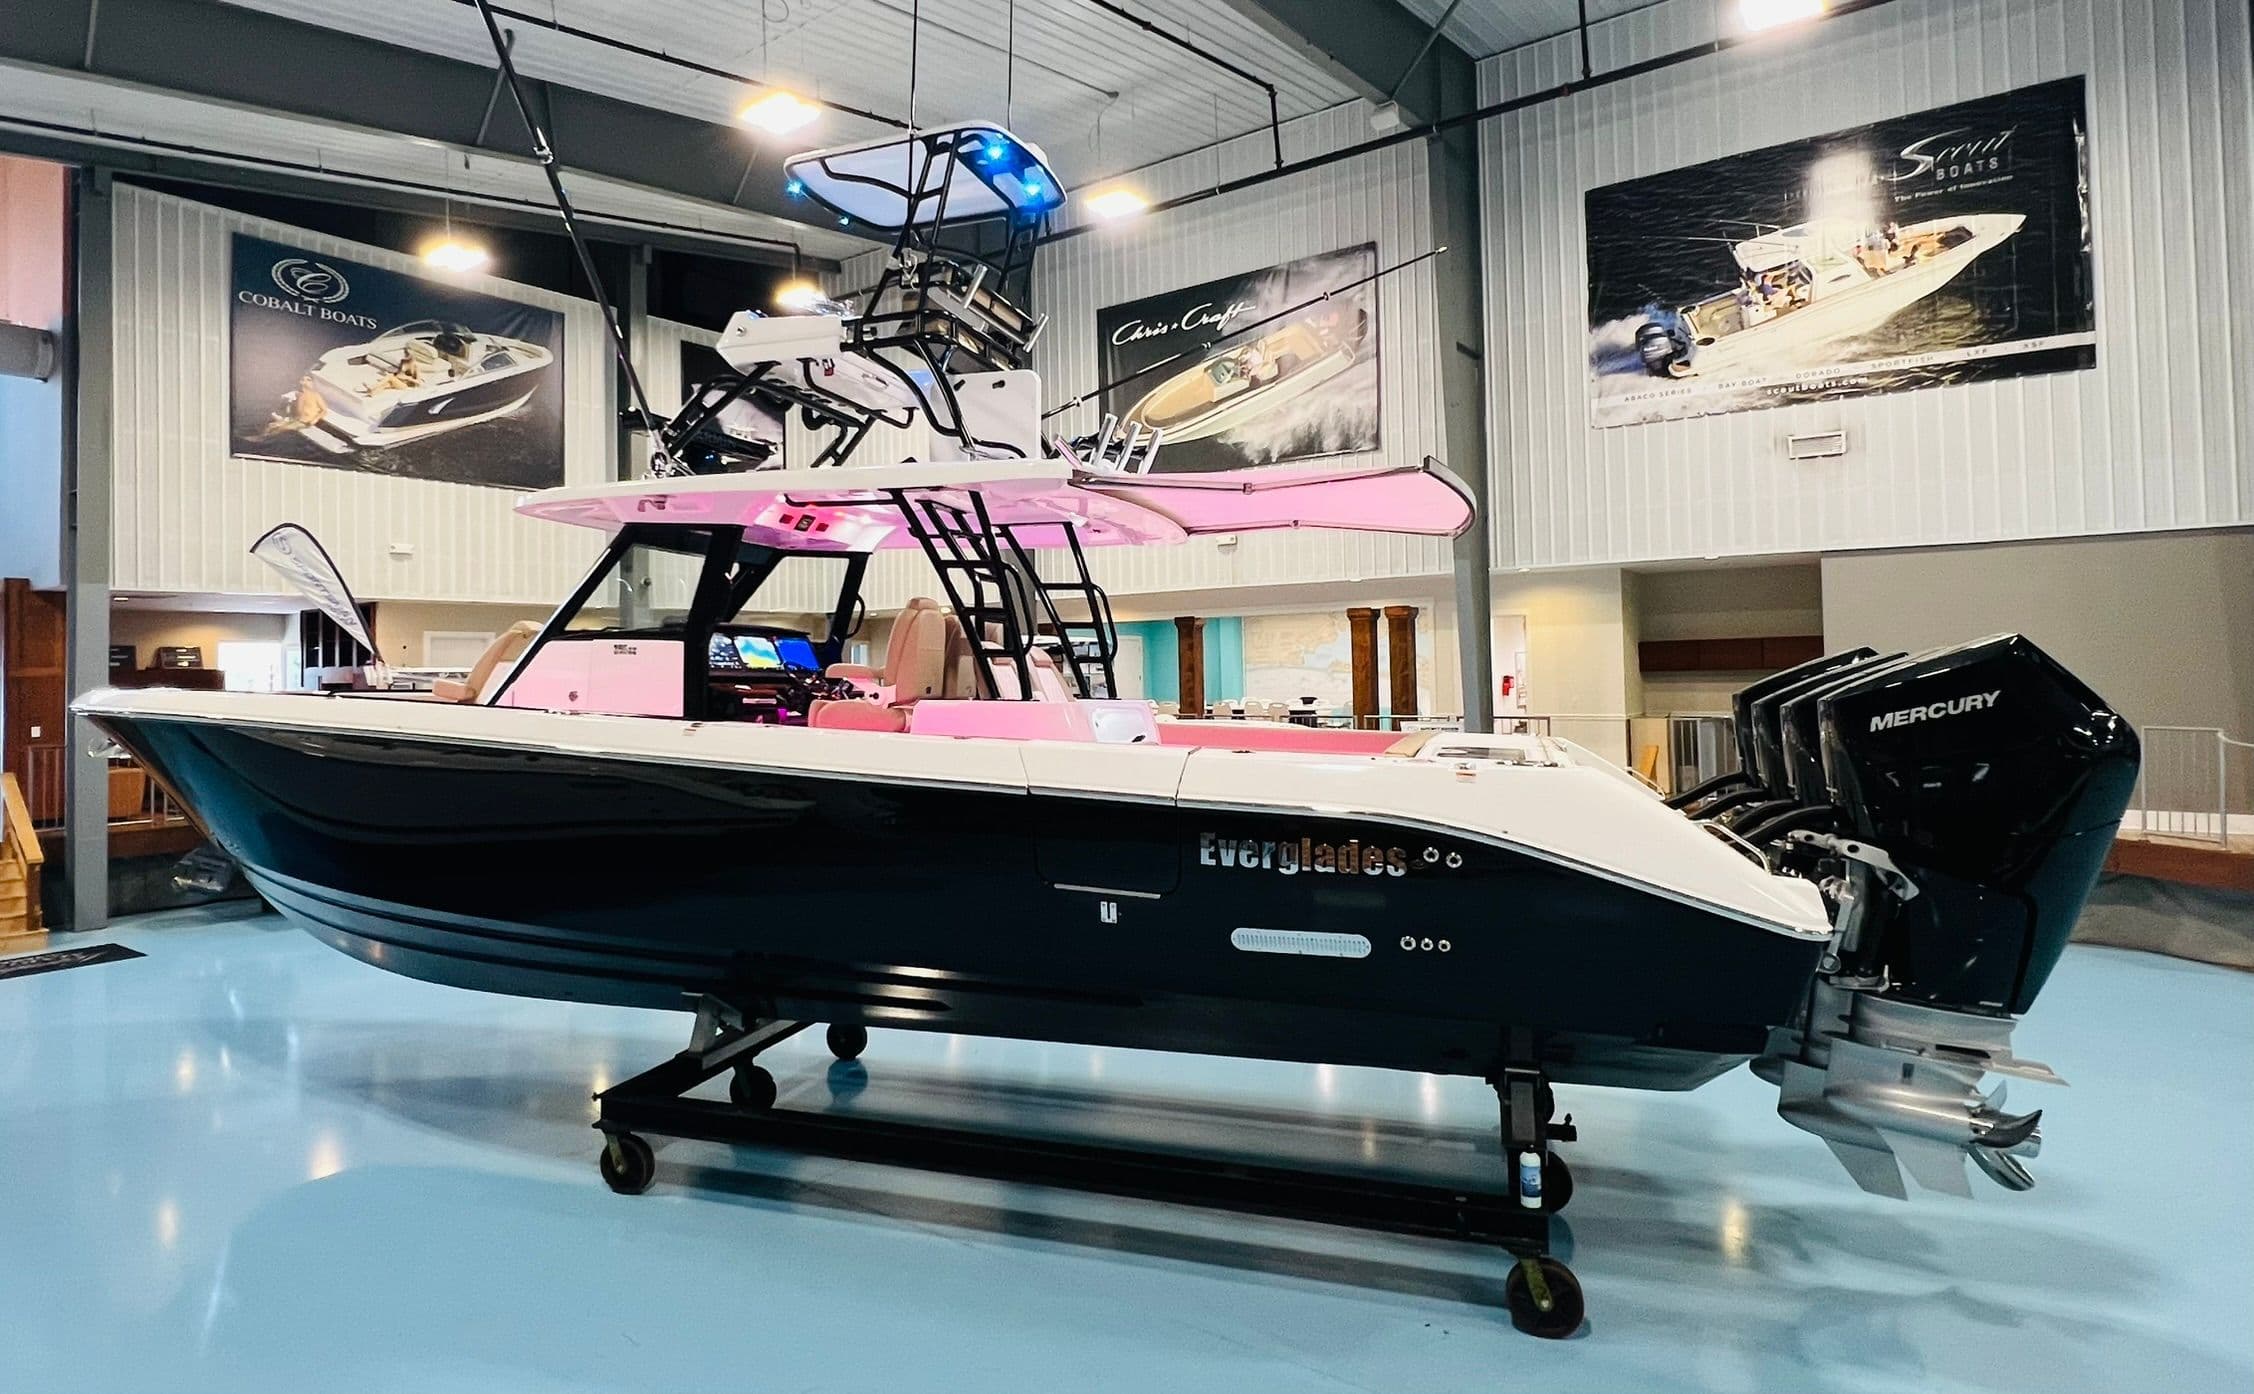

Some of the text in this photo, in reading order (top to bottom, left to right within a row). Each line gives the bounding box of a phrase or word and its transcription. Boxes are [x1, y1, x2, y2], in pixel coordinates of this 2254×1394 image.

[1935, 157, 1999, 181] BOATS
[1894, 194, 1912, 202] The
[1915, 188, 1944, 198] Power
[1947, 184, 1957, 192] of
[238, 290, 377, 330] COBALT BOATS
[1181, 302, 1256, 331] Craft
[1624, 393, 1656, 402] ABACO
[1659, 387, 1692, 397] SERIES
[1718, 381, 1737, 389] BAY
[1741, 377, 1768, 387] BOAT
[1795, 367, 1841, 380] DORADO
[1871, 355, 1934, 369] SPORTFISH
[1766, 376, 1869, 397] scoutboats.com
[1869, 689, 2002, 733] MERCURY
[1200, 831, 1407, 877] Everglades
